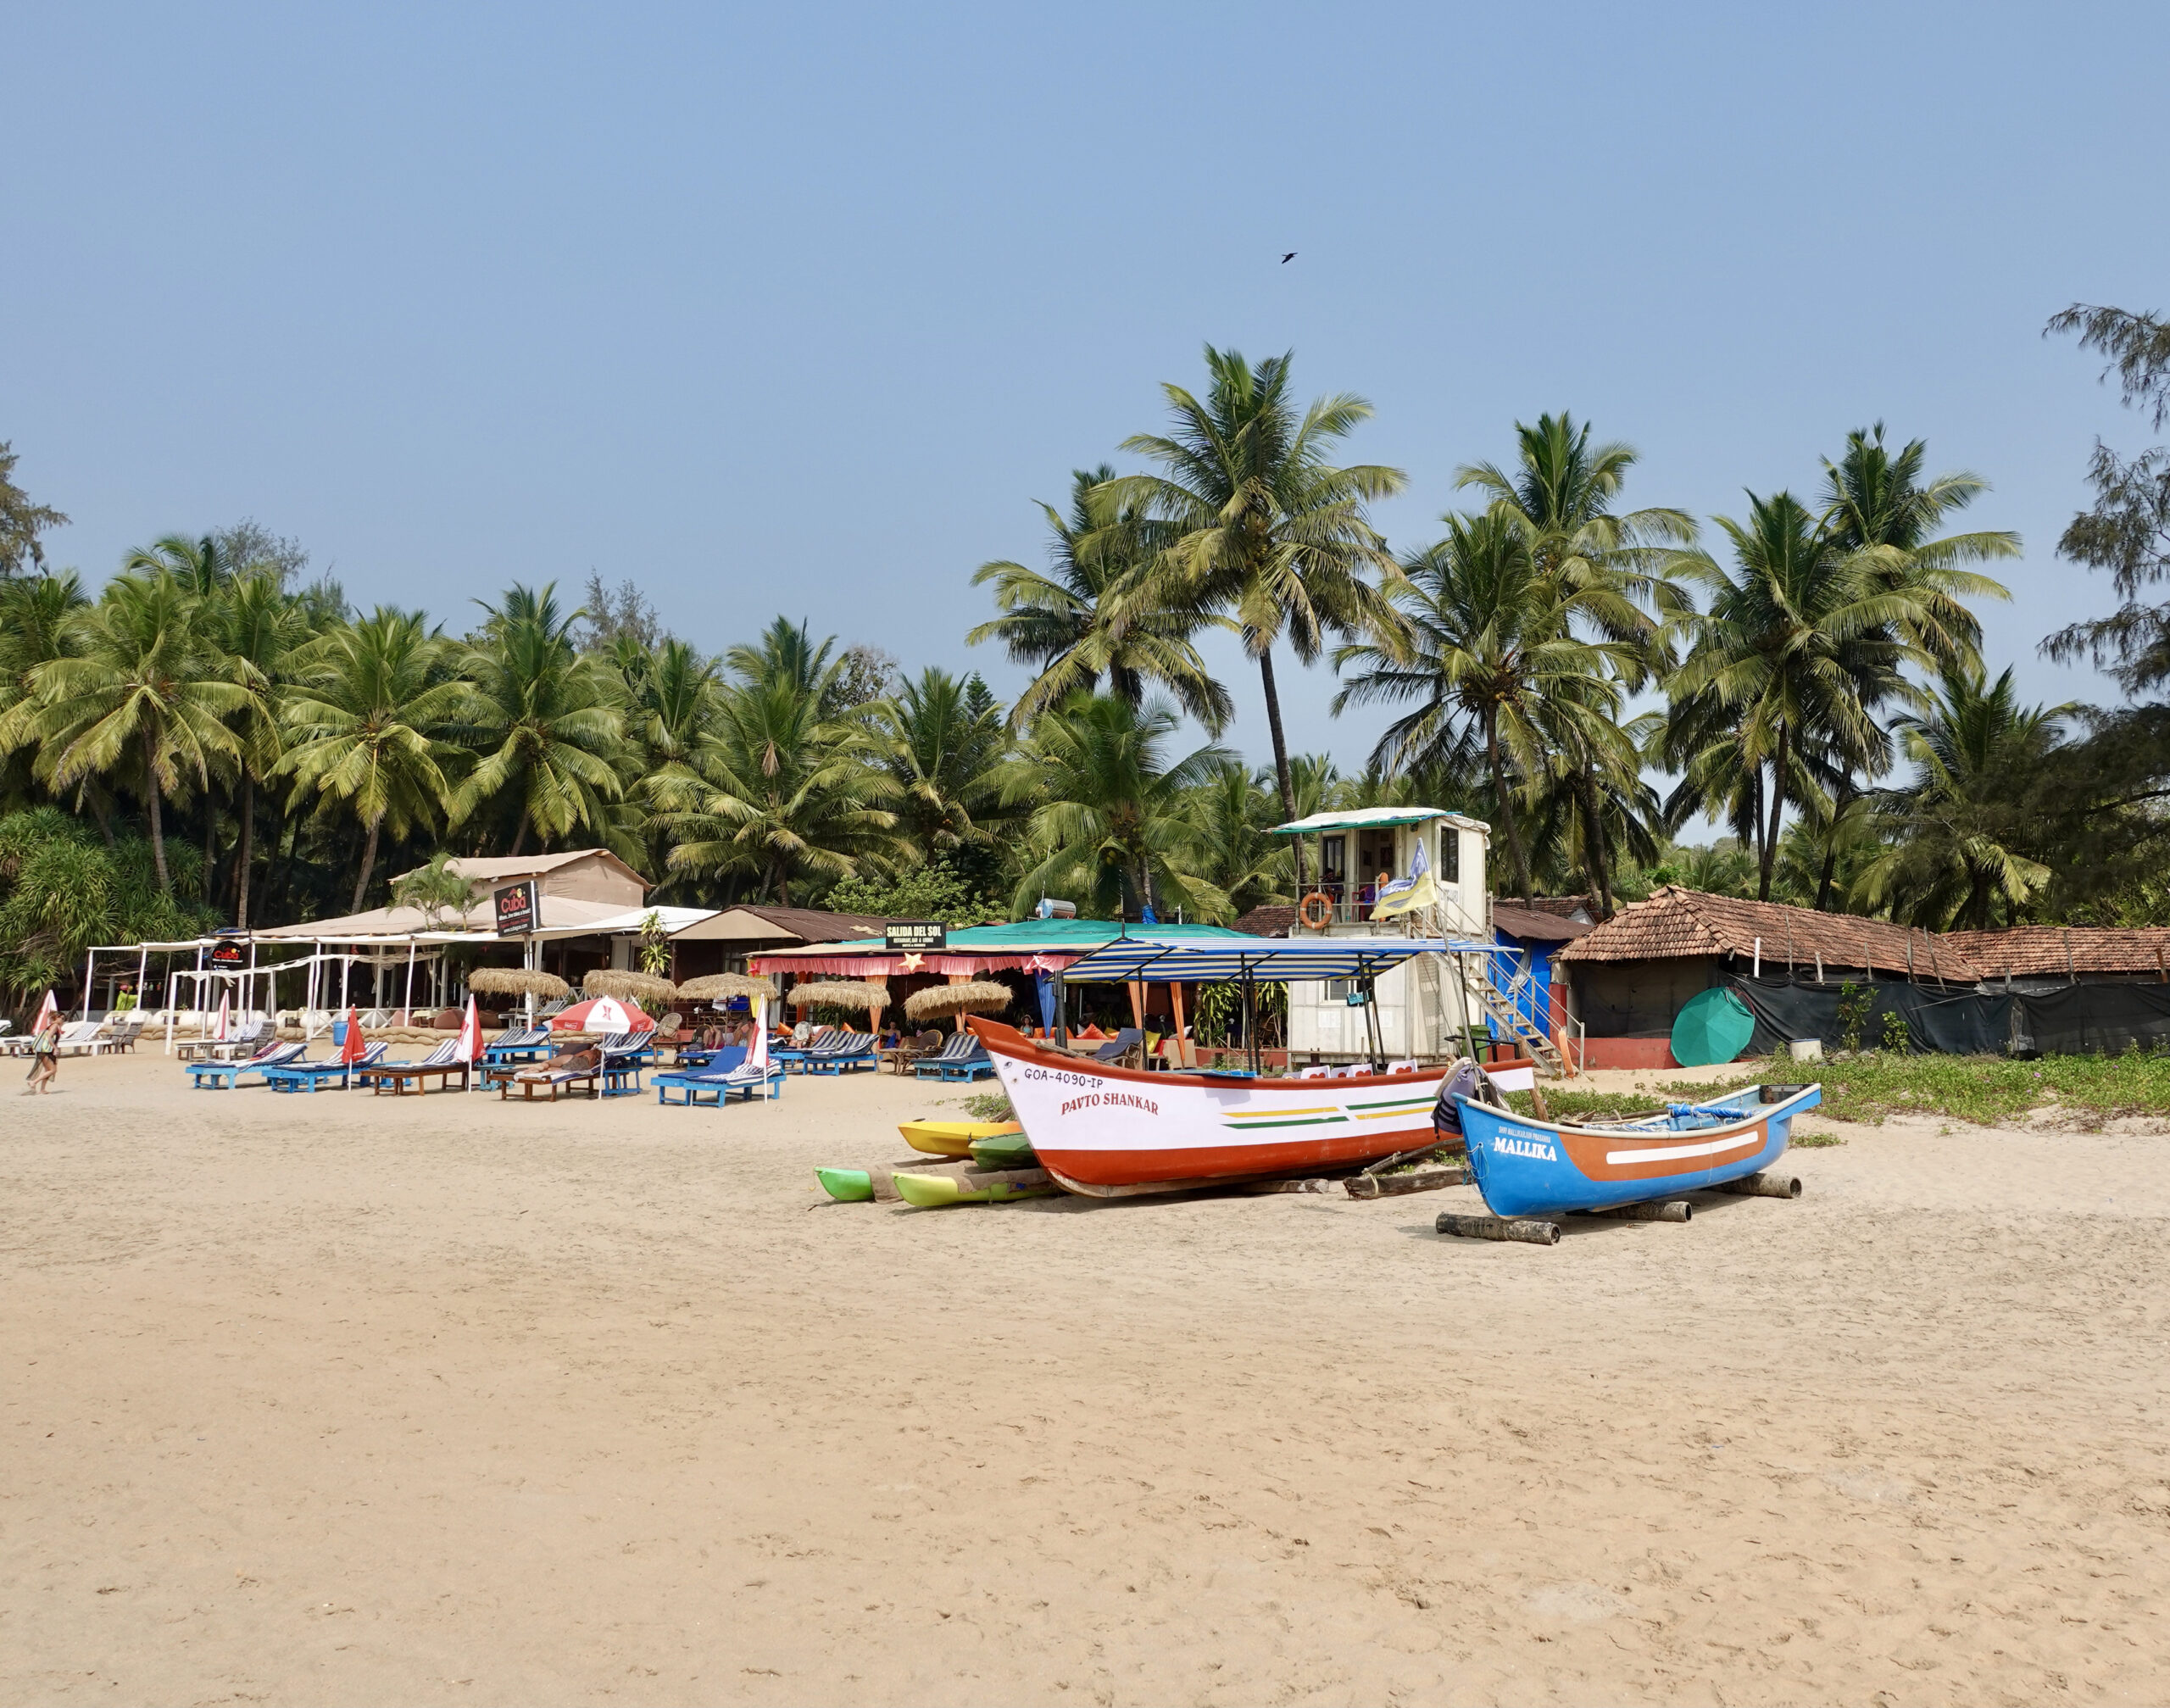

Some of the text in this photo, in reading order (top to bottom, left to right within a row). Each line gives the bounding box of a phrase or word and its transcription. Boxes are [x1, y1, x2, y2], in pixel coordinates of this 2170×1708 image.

[501, 896, 526, 913] Cuba
[887, 926, 942, 937] SALIDA DEL SOL
[214, 950, 239, 960] Cuba
[1024, 1068, 1104, 1089] GOA-4090-IP
[1061, 1093, 1159, 1115] PAVTO SHANKAR
[1494, 1137, 1557, 1161] MALLIKA
